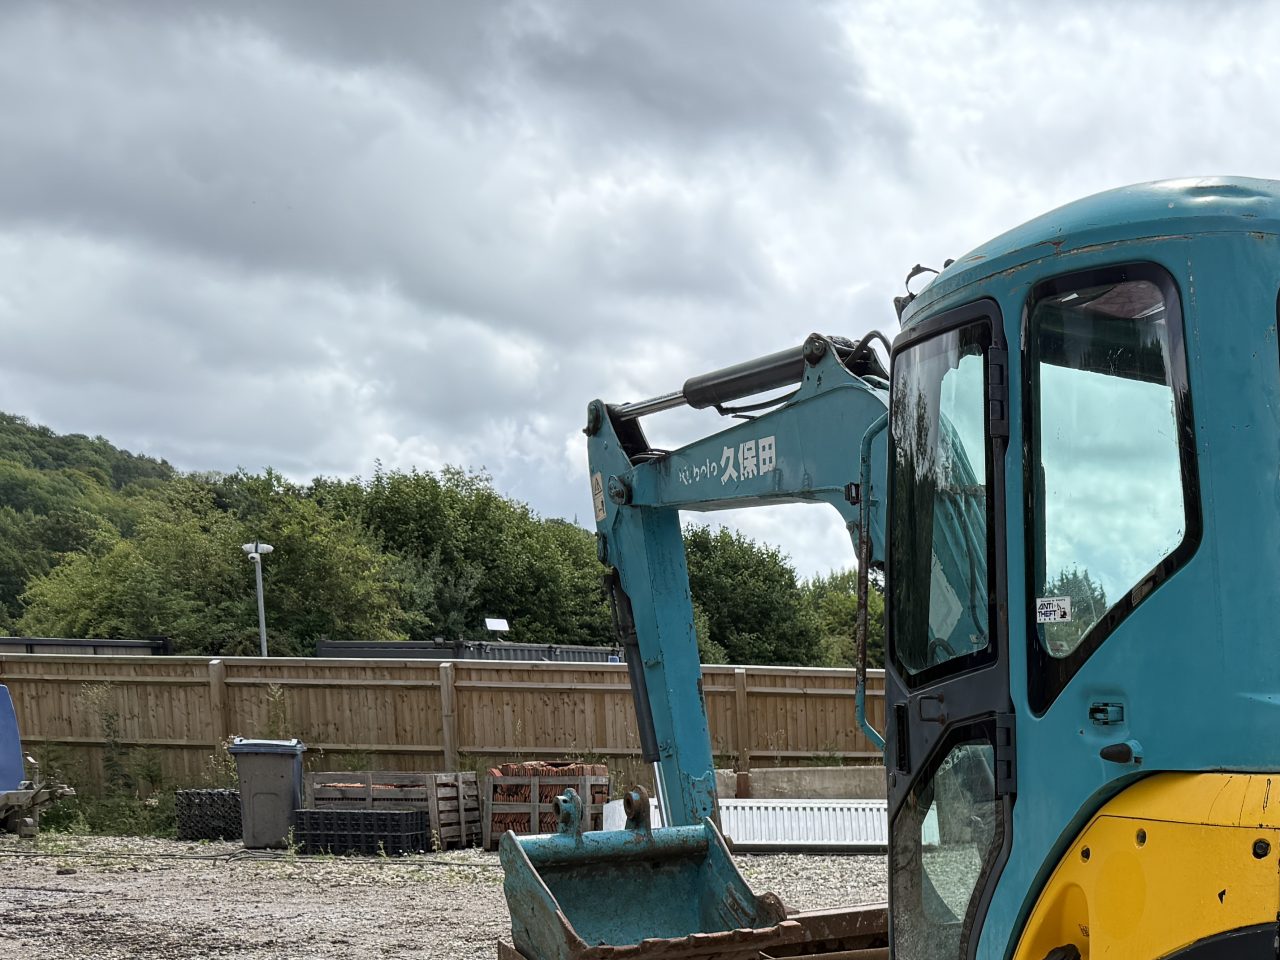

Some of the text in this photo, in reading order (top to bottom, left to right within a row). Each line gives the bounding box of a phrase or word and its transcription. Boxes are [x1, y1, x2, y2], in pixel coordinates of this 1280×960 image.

[720, 435, 777, 486] 久保田
[1038, 610, 1057, 618] THEFT
